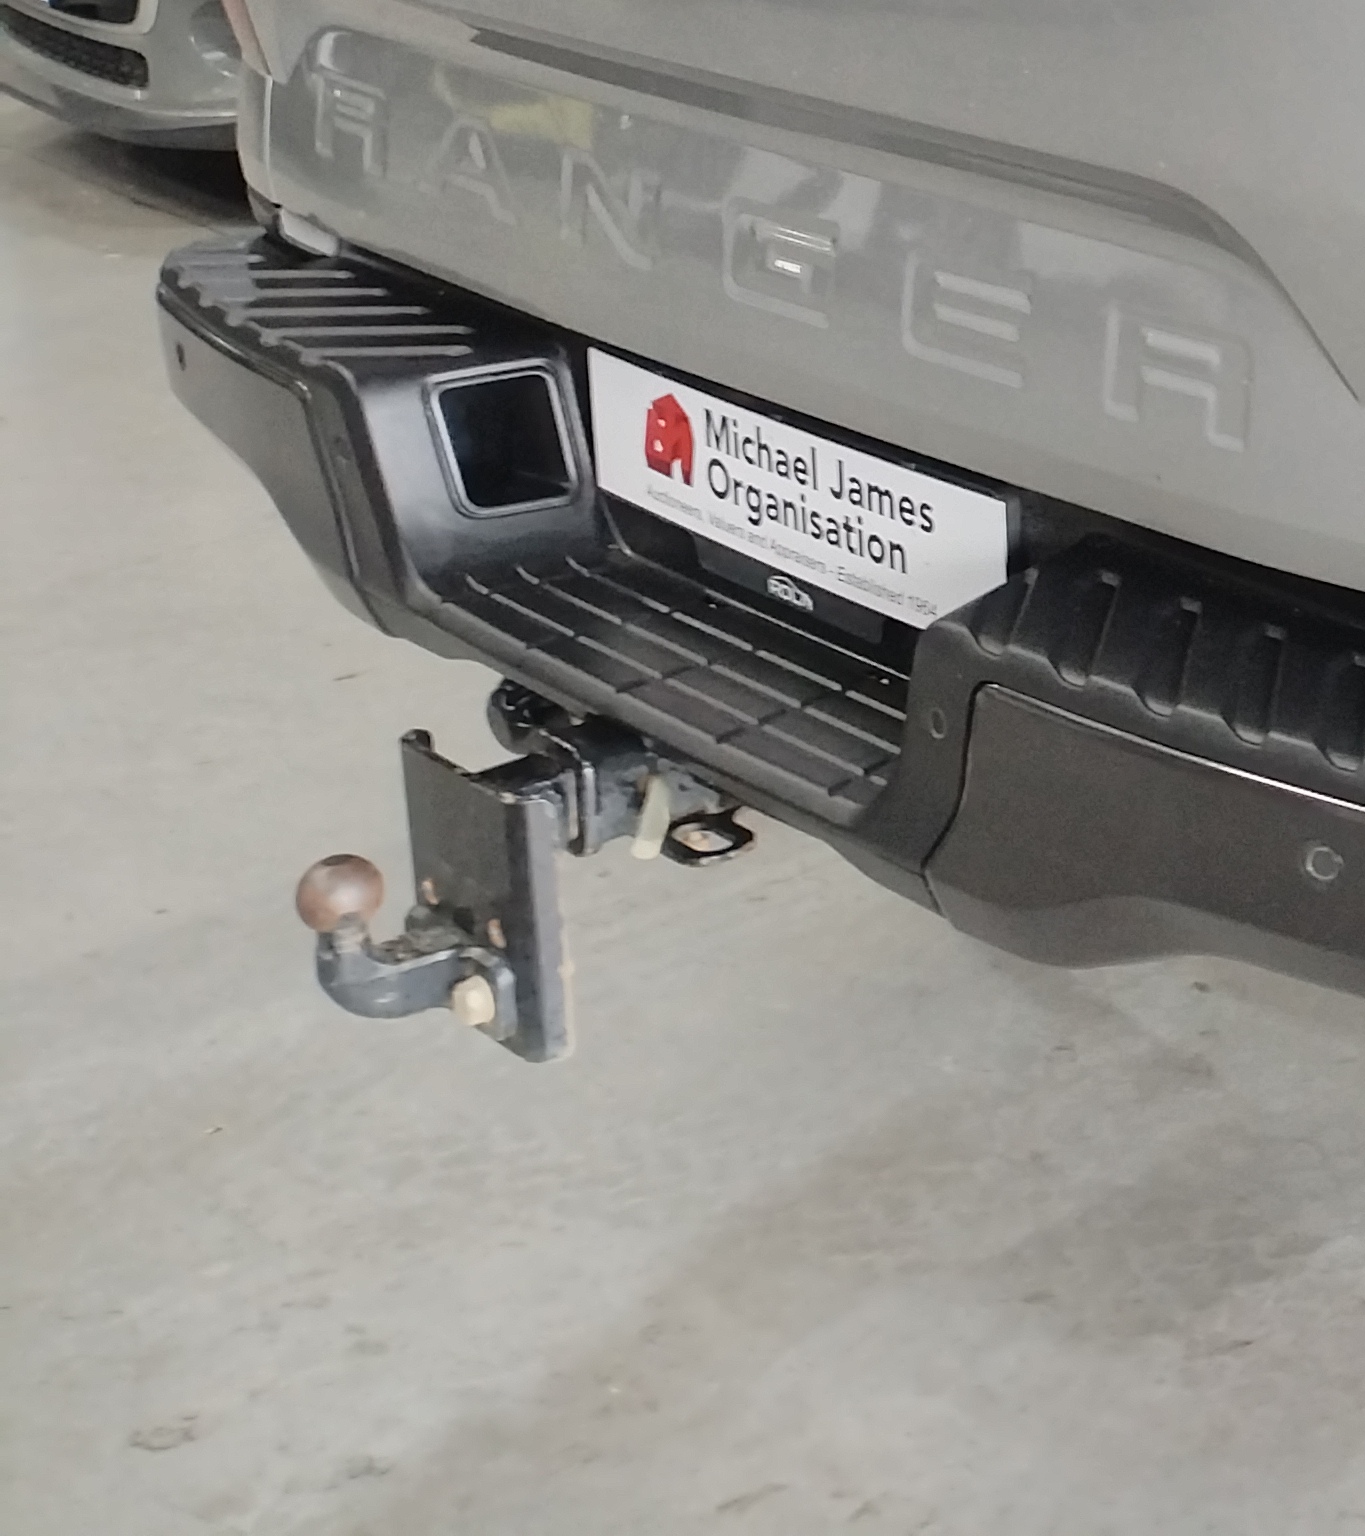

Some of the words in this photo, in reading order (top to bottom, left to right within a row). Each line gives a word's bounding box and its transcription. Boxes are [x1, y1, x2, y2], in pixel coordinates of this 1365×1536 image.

[312, 66, 1255, 456] RANGER
[705, 408, 819, 491] Michael
[830, 460, 935, 534] James
[707, 458, 908, 574] Organisation
